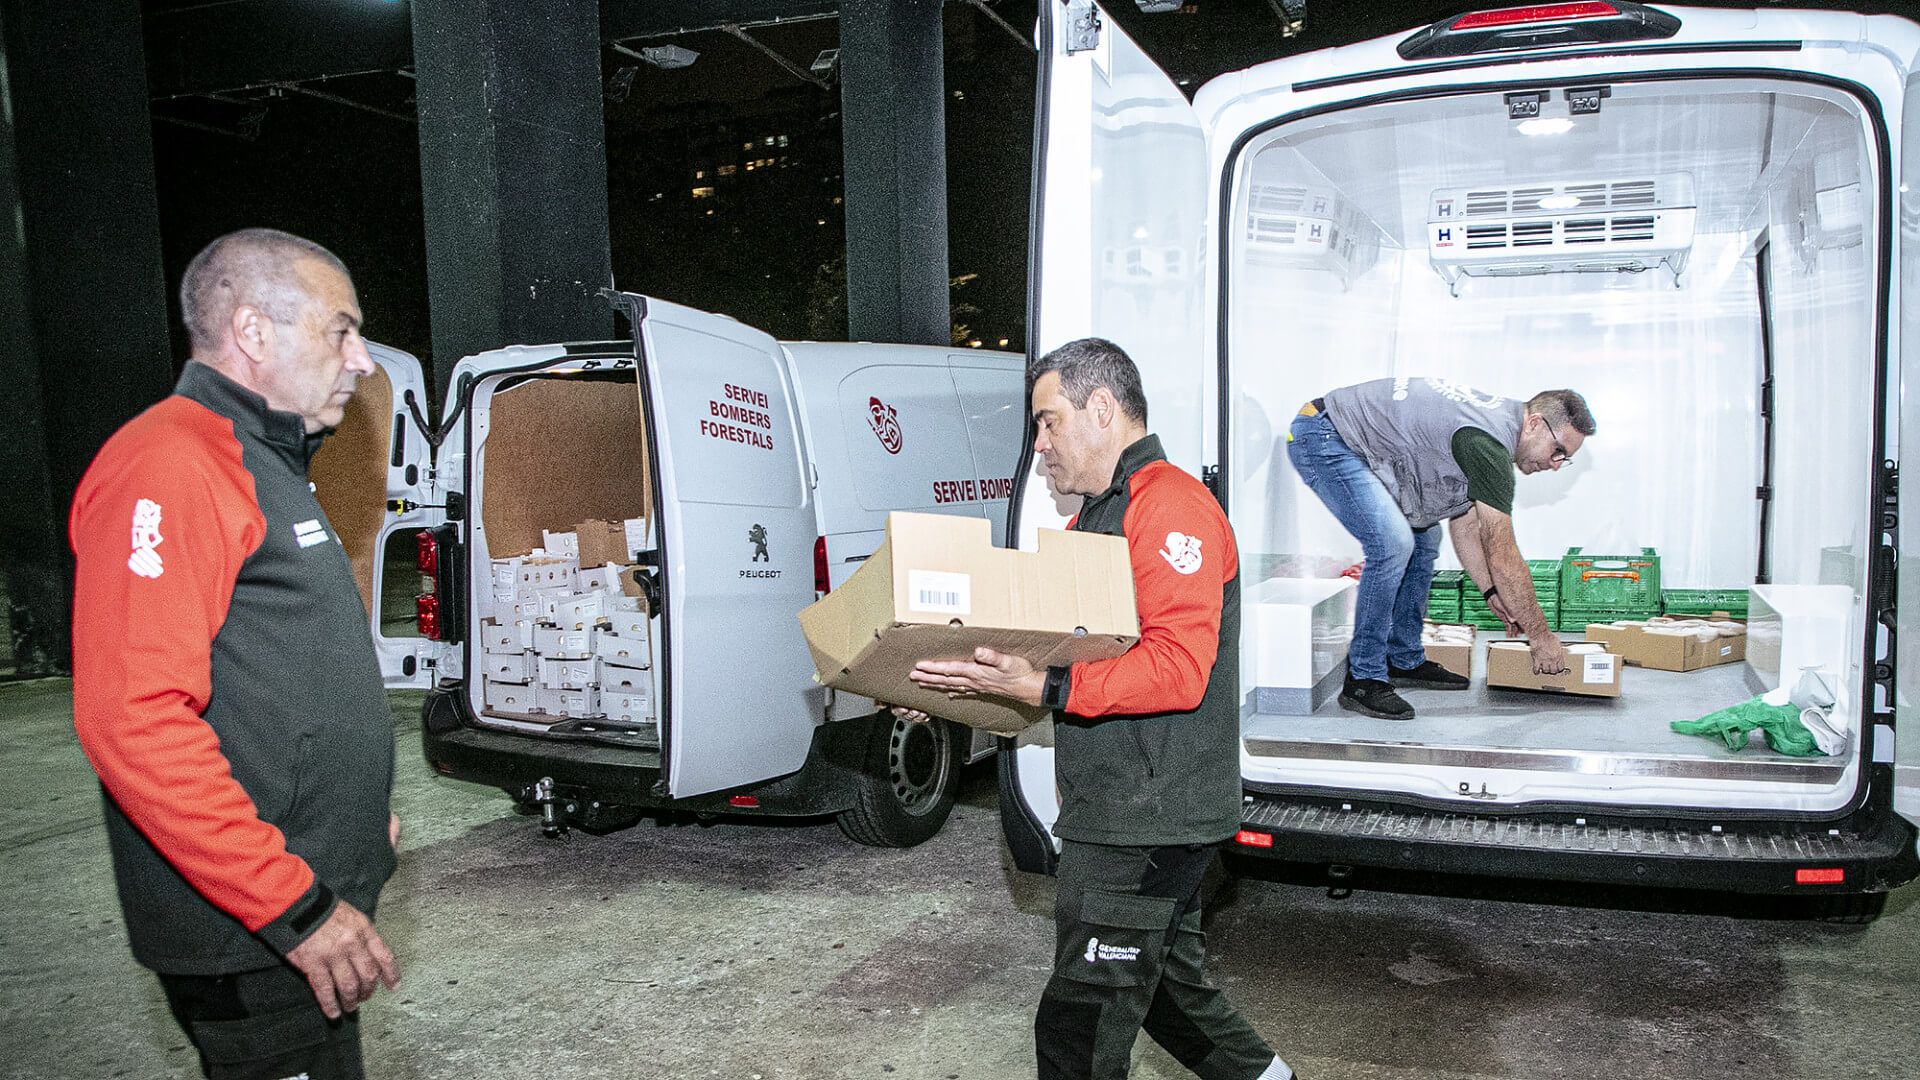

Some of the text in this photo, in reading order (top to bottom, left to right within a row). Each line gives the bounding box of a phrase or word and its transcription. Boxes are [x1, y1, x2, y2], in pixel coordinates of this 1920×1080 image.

[1438, 228, 1451, 241] H
[724, 383, 769, 409] SERVEI
[709, 400, 771, 430] BOMBERS
[700, 419, 773, 450] FORESTALS
[933, 480, 978, 503] SERVEI
[739, 570, 782, 578] PEUGEOT
